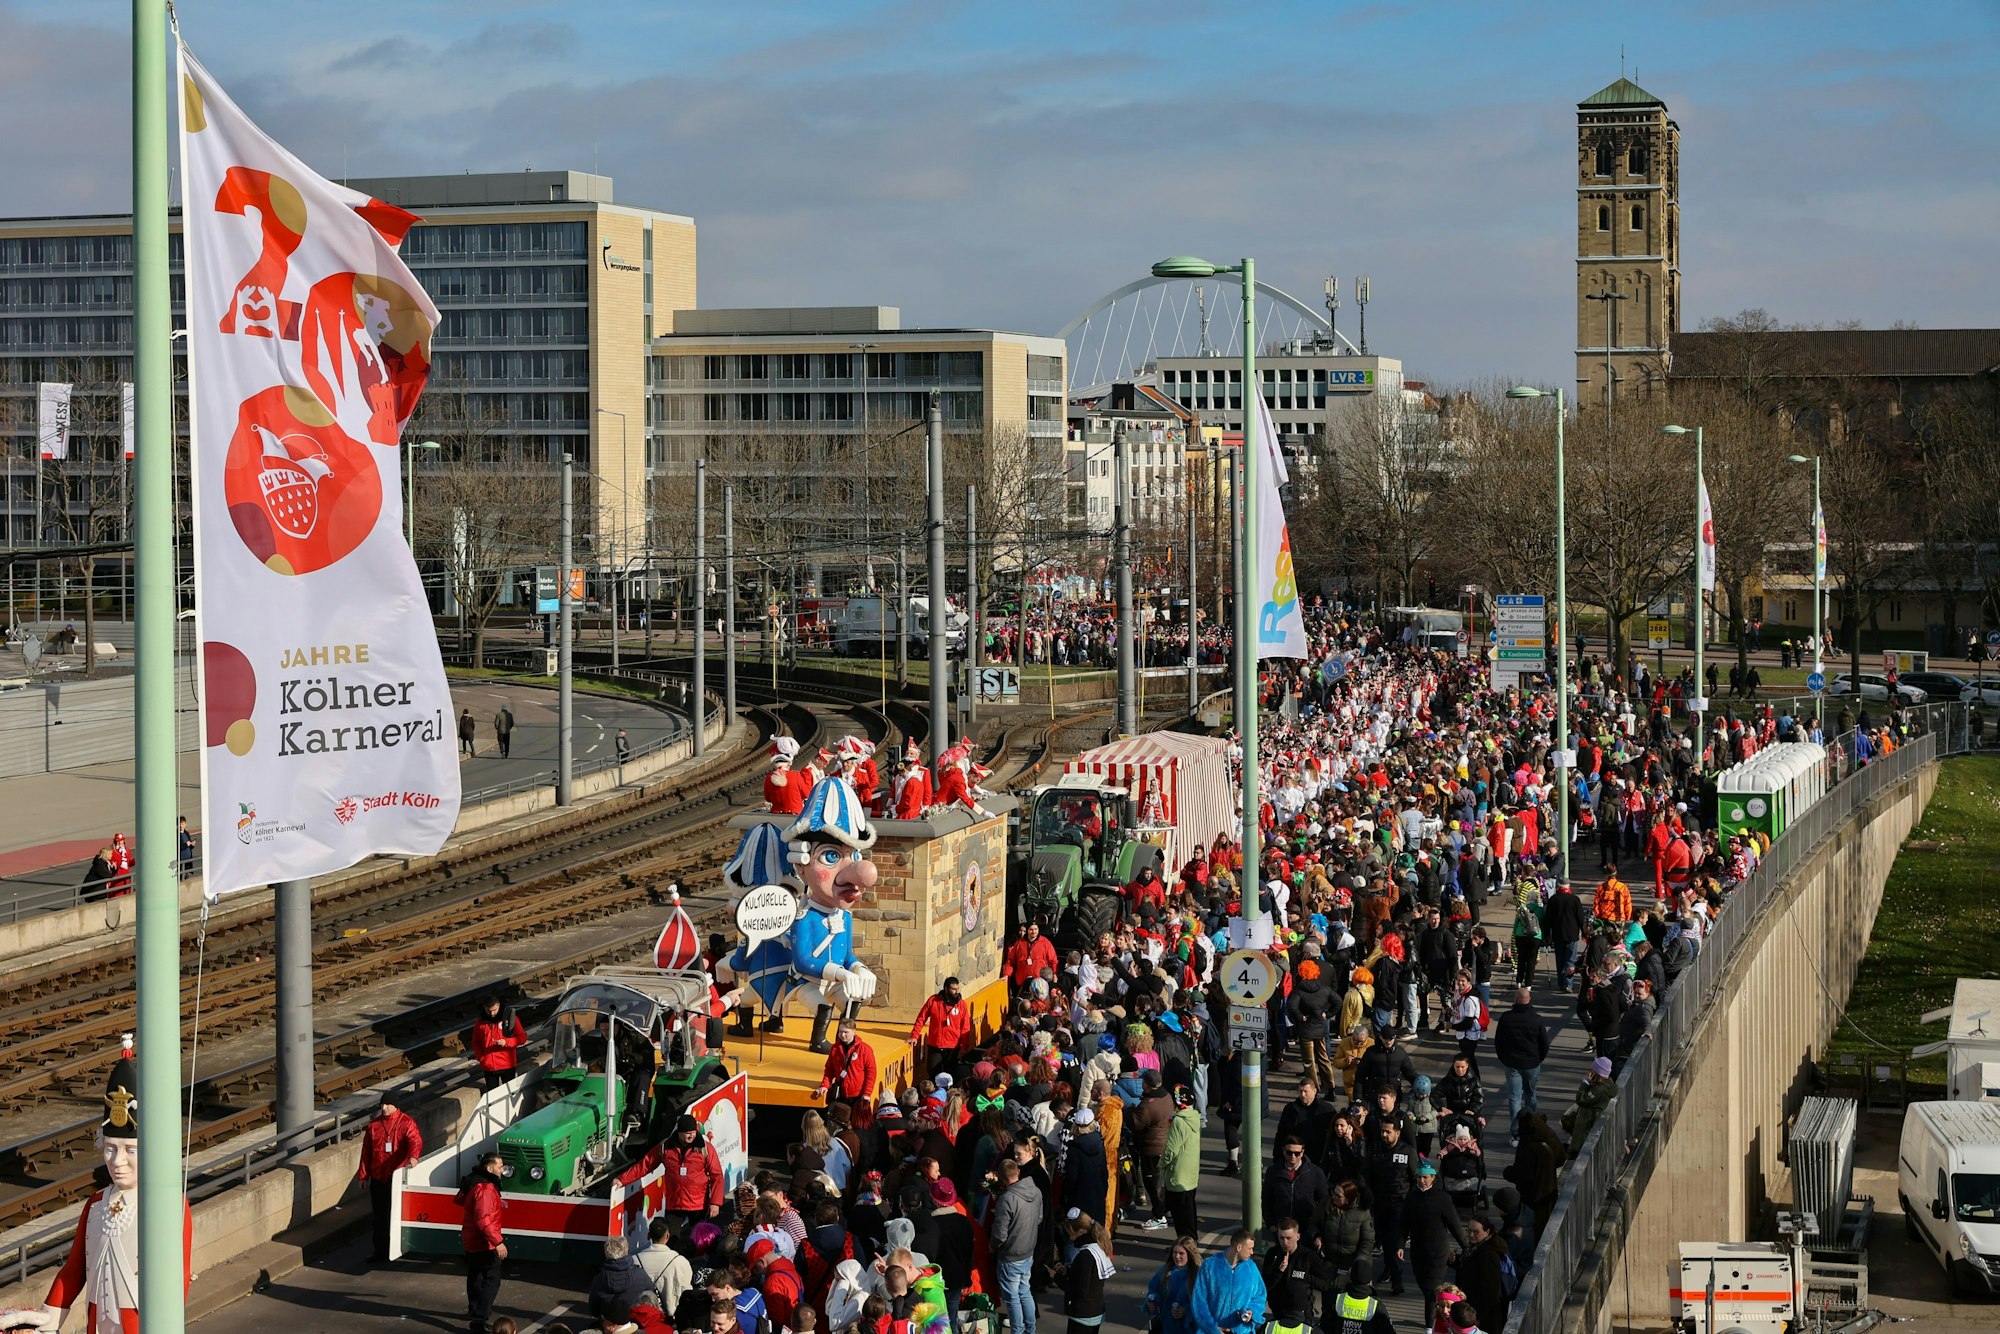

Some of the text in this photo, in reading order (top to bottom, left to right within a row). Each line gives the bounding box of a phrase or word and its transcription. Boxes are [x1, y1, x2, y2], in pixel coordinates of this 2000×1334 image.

[1332, 372, 1356, 382] LVR
[55, 402, 69, 444] LANXESS
[280, 644, 369, 669] JAHRE
[280, 677, 414, 715] Kölner
[278, 709, 442, 757] Karneval
[363, 791, 440, 812] Stadt Köln
[255, 823, 306, 836] Kölner Karneval
[744, 892, 788, 912] KULTURELLE
[742, 914, 791, 931] ANEIGNUNG!!!
[1245, 928, 1253, 939] 4
[1238, 970, 1250, 985] 4
[1252, 1014, 1262, 1023] m
[1392, 1153, 1409, 1165] FBI
[416, 1212, 430, 1222] 42
[1291, 1270, 1306, 1280] SWAT
[1343, 1320, 1363, 1329] NRW
